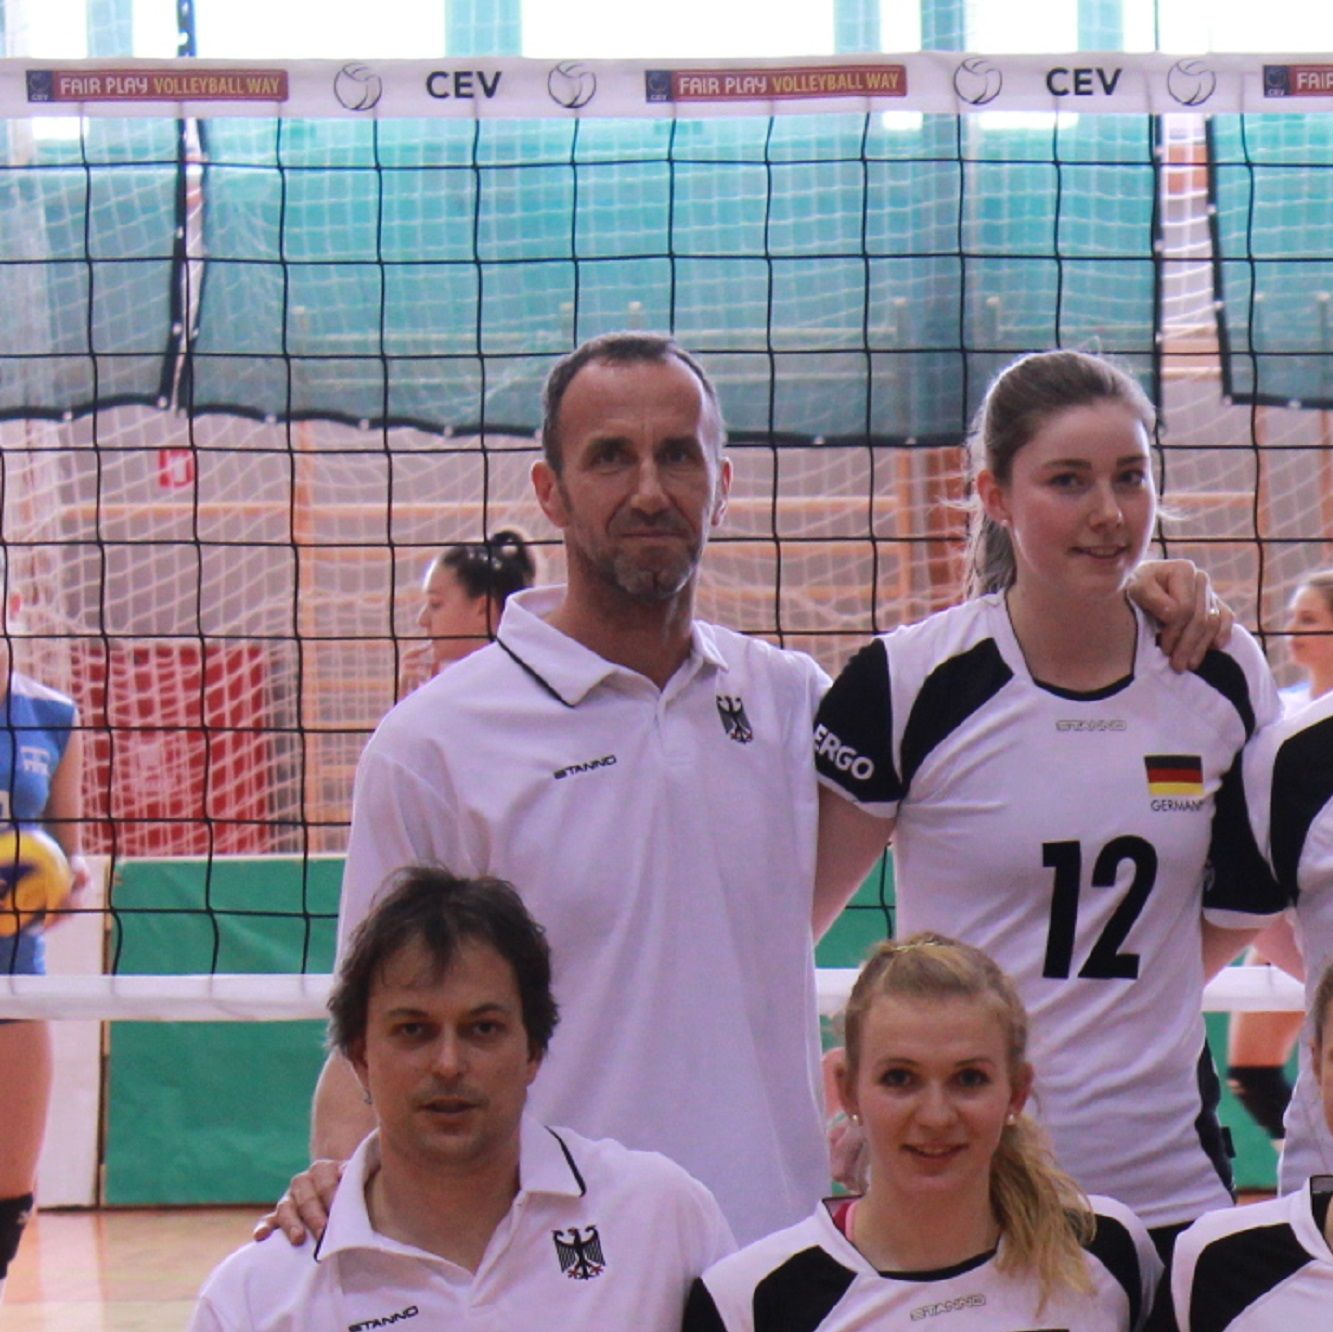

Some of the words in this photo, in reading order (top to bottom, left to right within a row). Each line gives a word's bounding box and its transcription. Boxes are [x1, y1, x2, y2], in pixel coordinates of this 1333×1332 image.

[60, 77, 101, 94] FAIR
[105, 77, 148, 94] PLAY
[153, 77, 244, 94] VOLLEYBALL
[247, 77, 280, 94] WAY
[426, 70, 502, 99] CEV
[679, 77, 719, 94] FAIR
[725, 76, 767, 94] PLAY
[771, 74, 863, 91] VOLLEYBALL
[865, 72, 898, 89] WAY
[1046, 67, 1122, 96] CEV
[813, 723, 874, 781] ERGO
[1041, 835, 1158, 980] 12
[910, 1293, 986, 1321] STANNO
